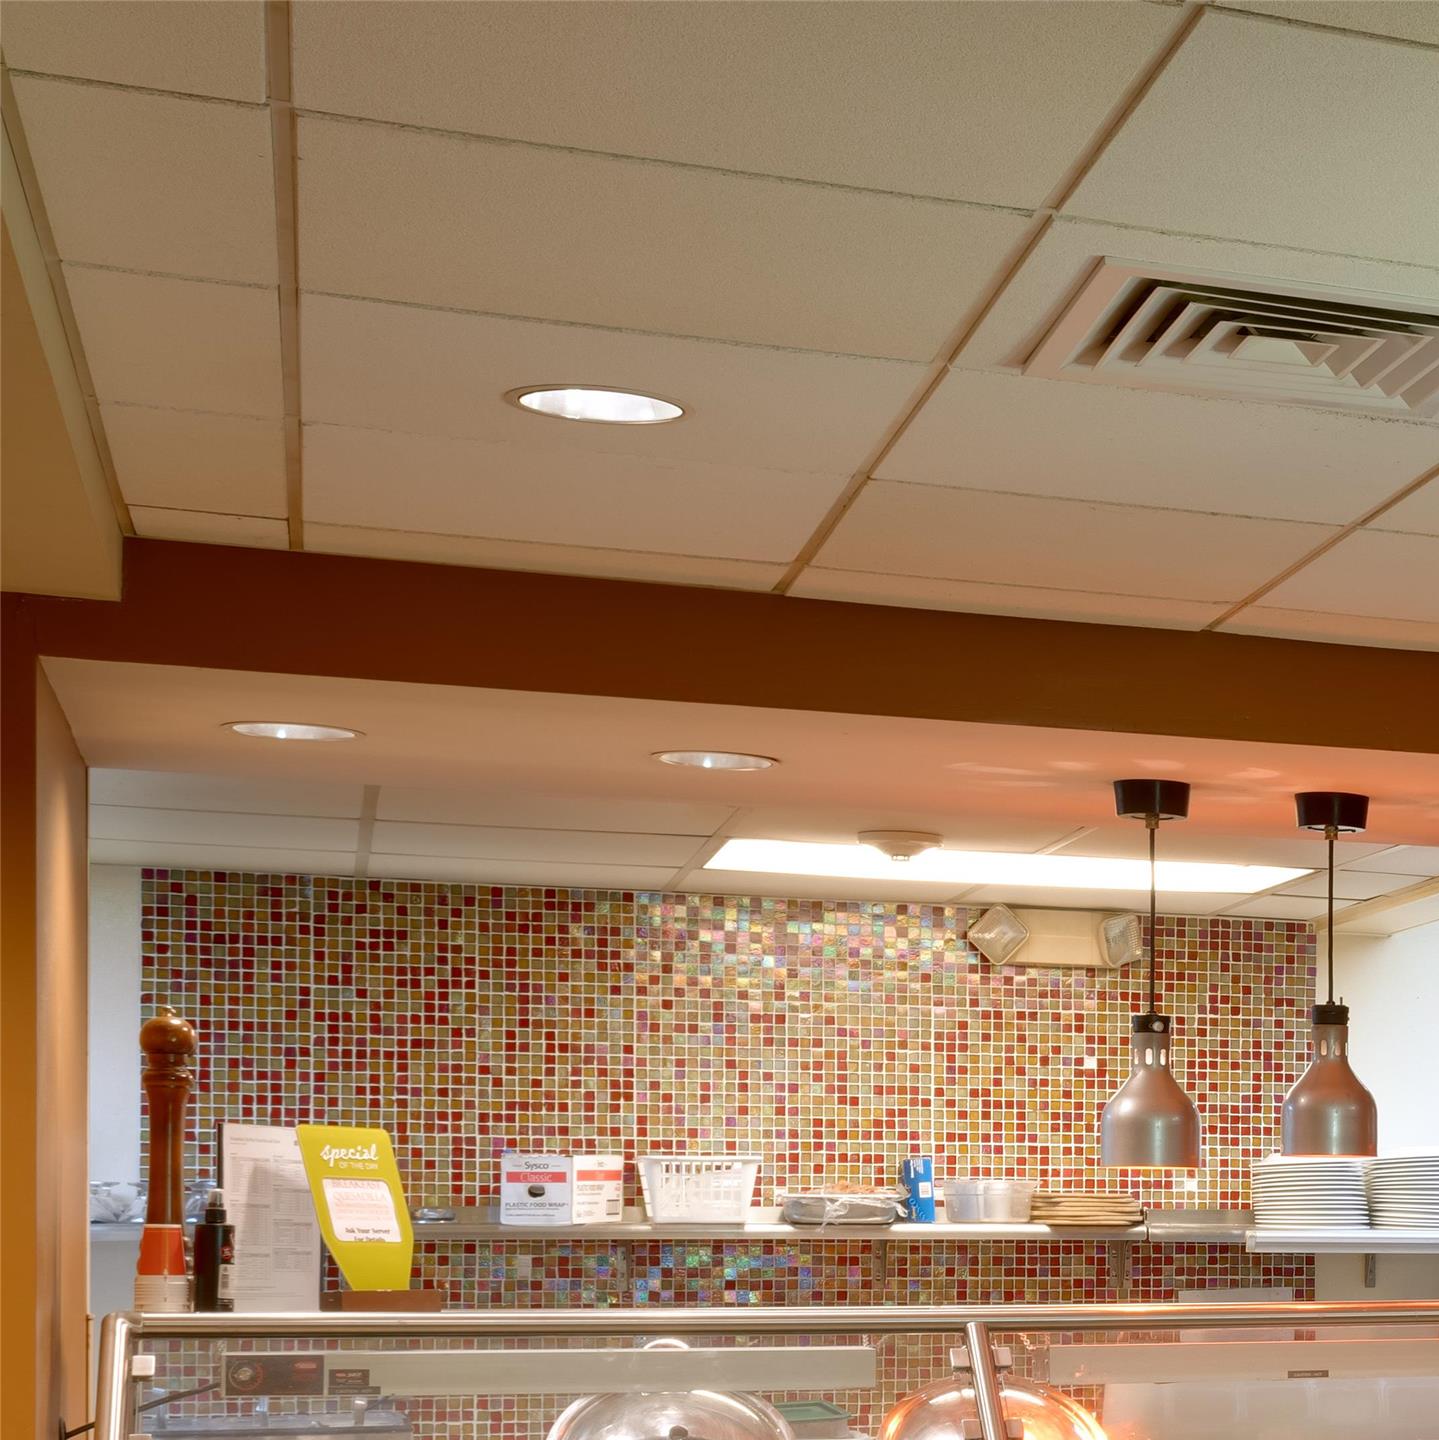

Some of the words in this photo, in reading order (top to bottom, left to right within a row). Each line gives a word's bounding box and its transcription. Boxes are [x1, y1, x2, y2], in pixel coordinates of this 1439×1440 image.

[320, 1143, 379, 1168] special
[524, 1160, 550, 1171] Sysco
[520, 1172, 552, 1183] Classic
